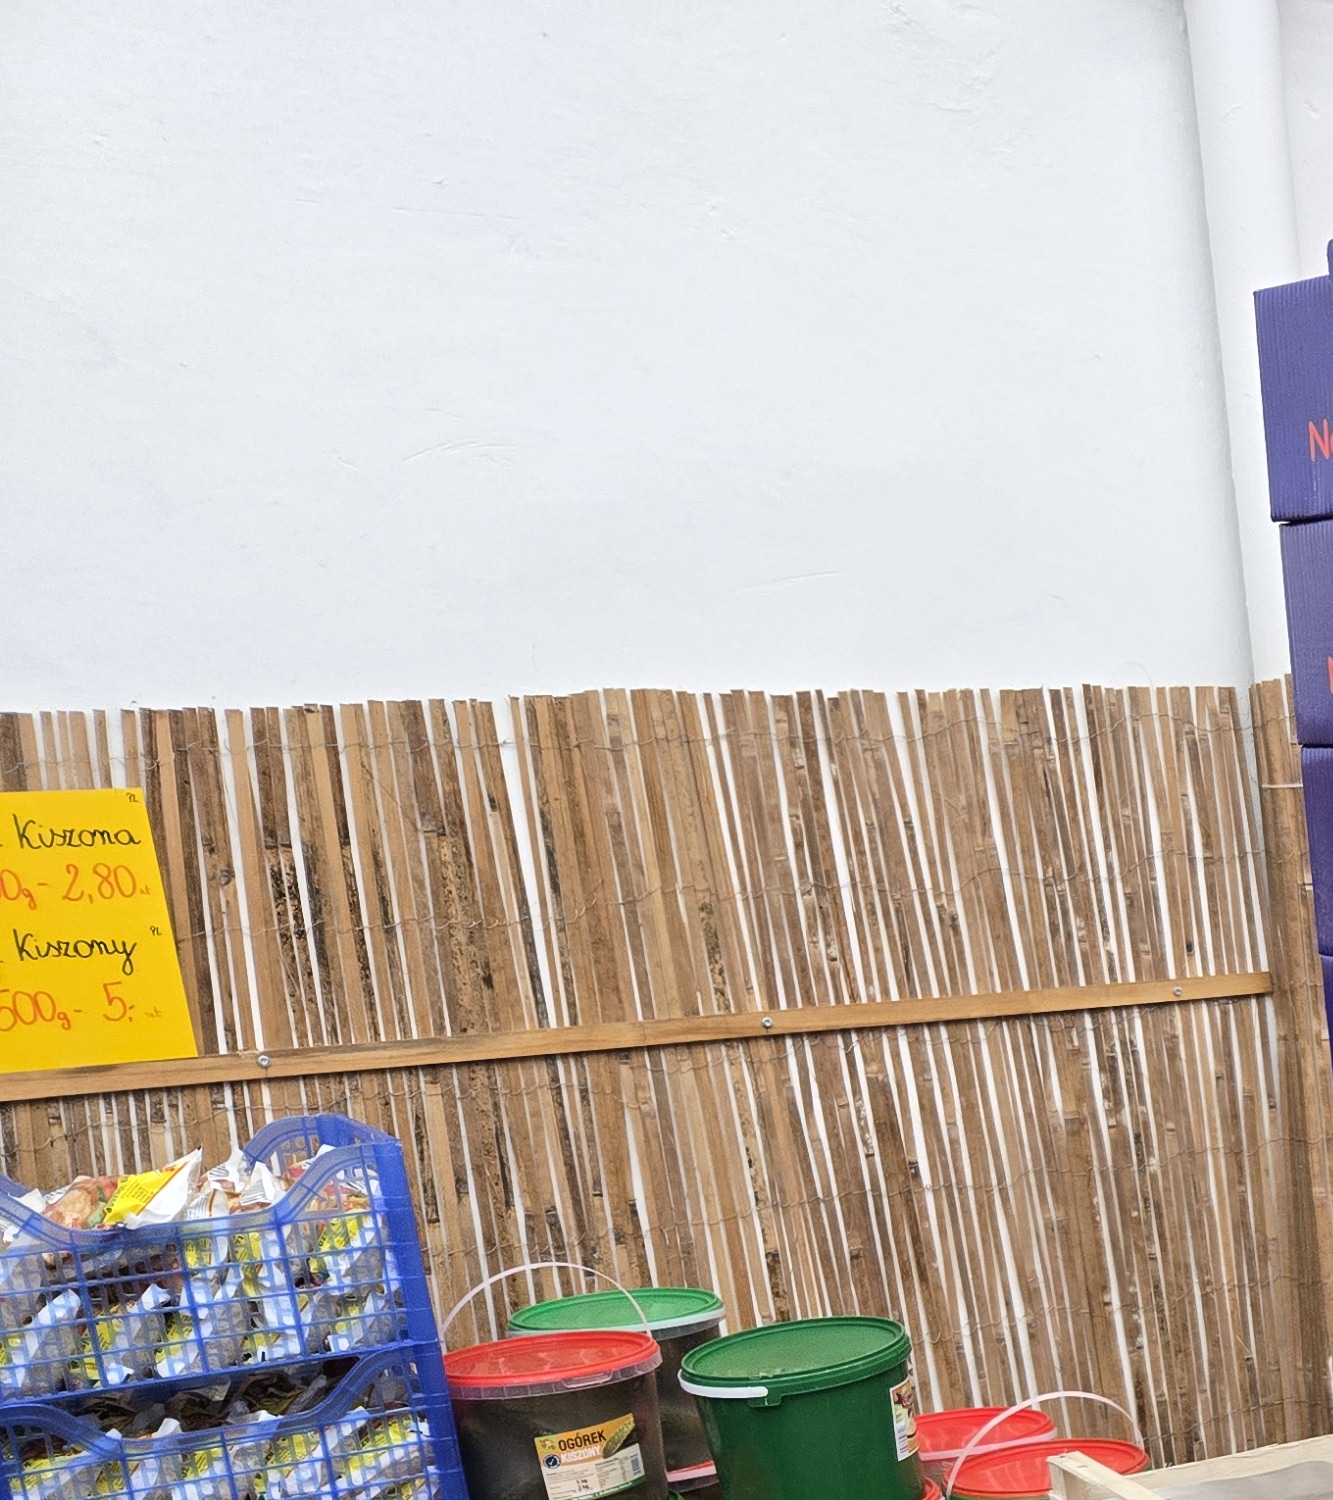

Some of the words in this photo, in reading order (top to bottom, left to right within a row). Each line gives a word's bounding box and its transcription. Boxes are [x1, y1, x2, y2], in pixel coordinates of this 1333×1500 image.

[12, 813, 141, 850] Kiszona
[62, 862, 136, 904] 2,80
[12, 928, 137, 976] Kiszony
[558, 1430, 606, 1452] OGÓREK
[560, 1447, 602, 1463] KISZONY
